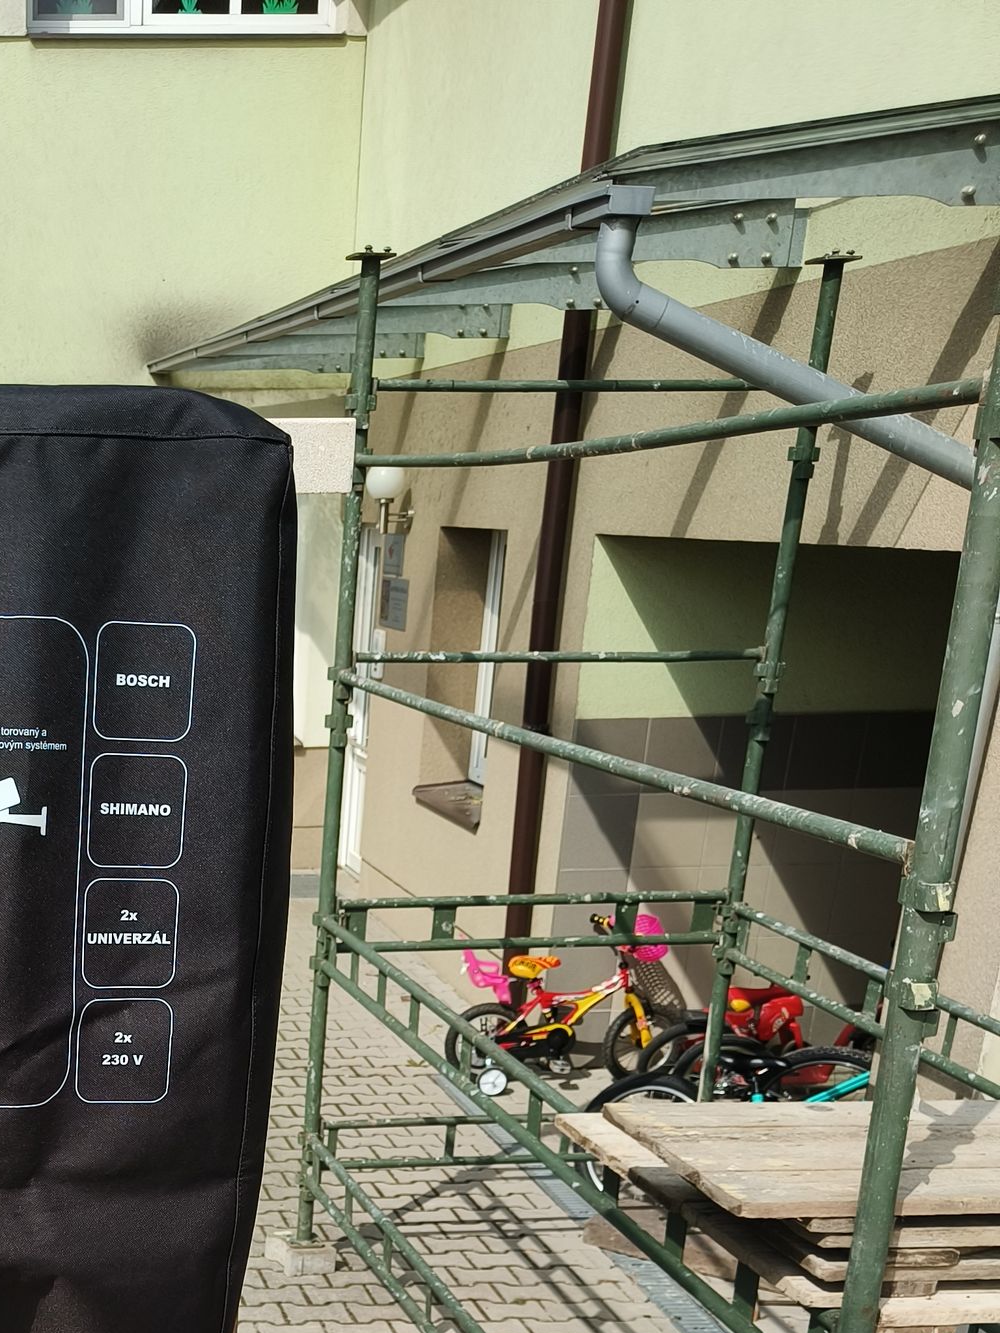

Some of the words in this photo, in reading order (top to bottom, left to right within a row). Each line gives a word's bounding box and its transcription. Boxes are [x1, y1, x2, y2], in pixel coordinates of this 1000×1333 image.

[116, 673, 171, 688] BOSCH
[25, 740, 67, 752] systémem
[100, 802, 171, 817] SHIMANO
[120, 909, 138, 921] 2x
[87, 930, 171, 945] UNIVERZÁL
[114, 1031, 132, 1043] 2x
[102, 1054, 129, 1066] 230
[133, 1054, 144, 1066] V
